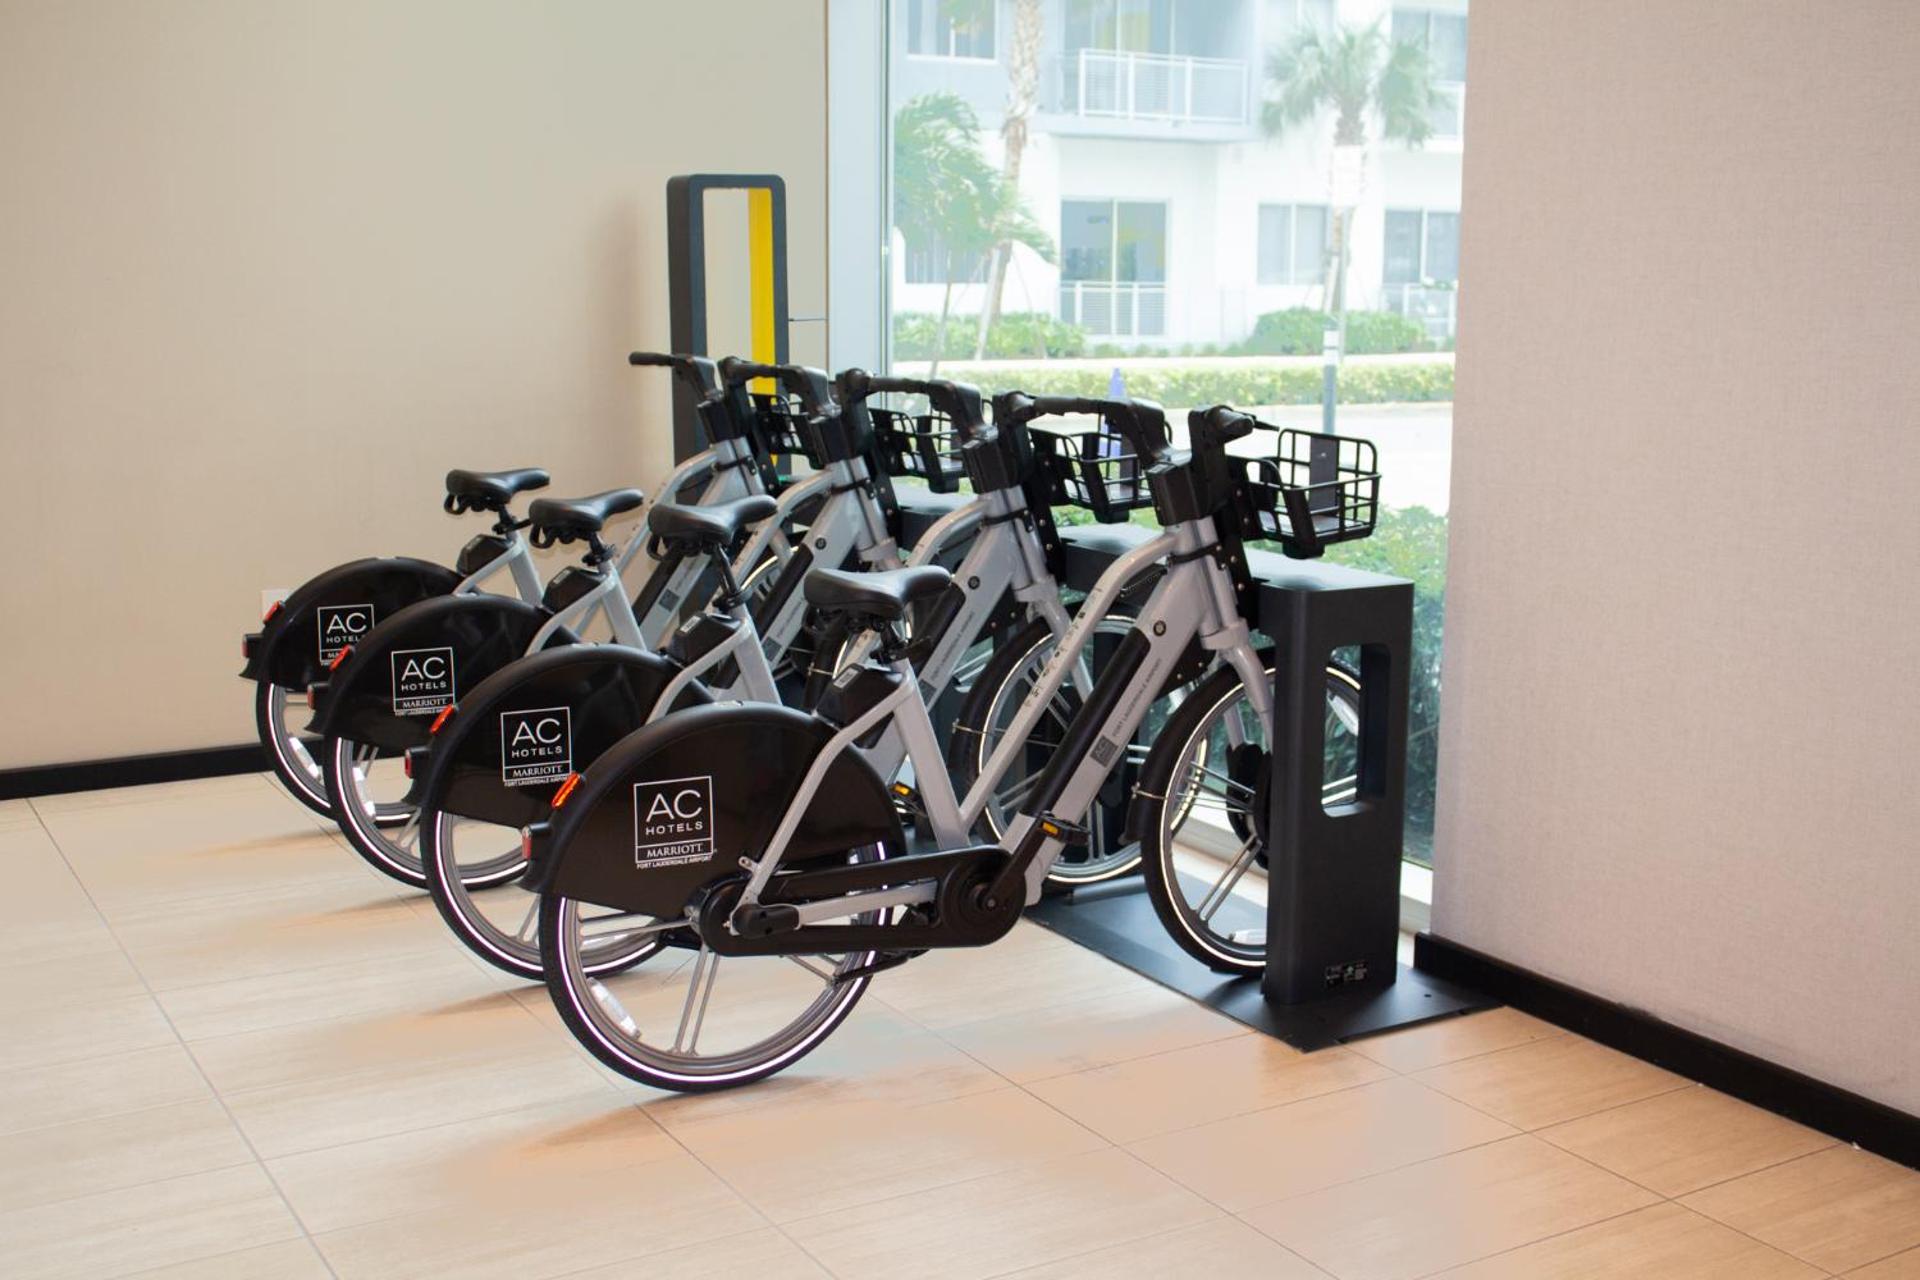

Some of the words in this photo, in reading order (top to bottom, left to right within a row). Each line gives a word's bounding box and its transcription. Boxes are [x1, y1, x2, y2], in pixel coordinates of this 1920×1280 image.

[326, 612, 367, 634] AC
[401, 656, 446, 681] AC
[401, 680, 447, 692] HOTELS
[403, 698, 447, 708] MARRIOTT
[512, 717, 562, 746] AC
[511, 745, 563, 758] HOTELS
[512, 765, 563, 777] MARRIOTT
[646, 789, 702, 822] AC
[645, 820, 704, 836] HOTELS
[647, 843, 703, 858] MARRIOTT
